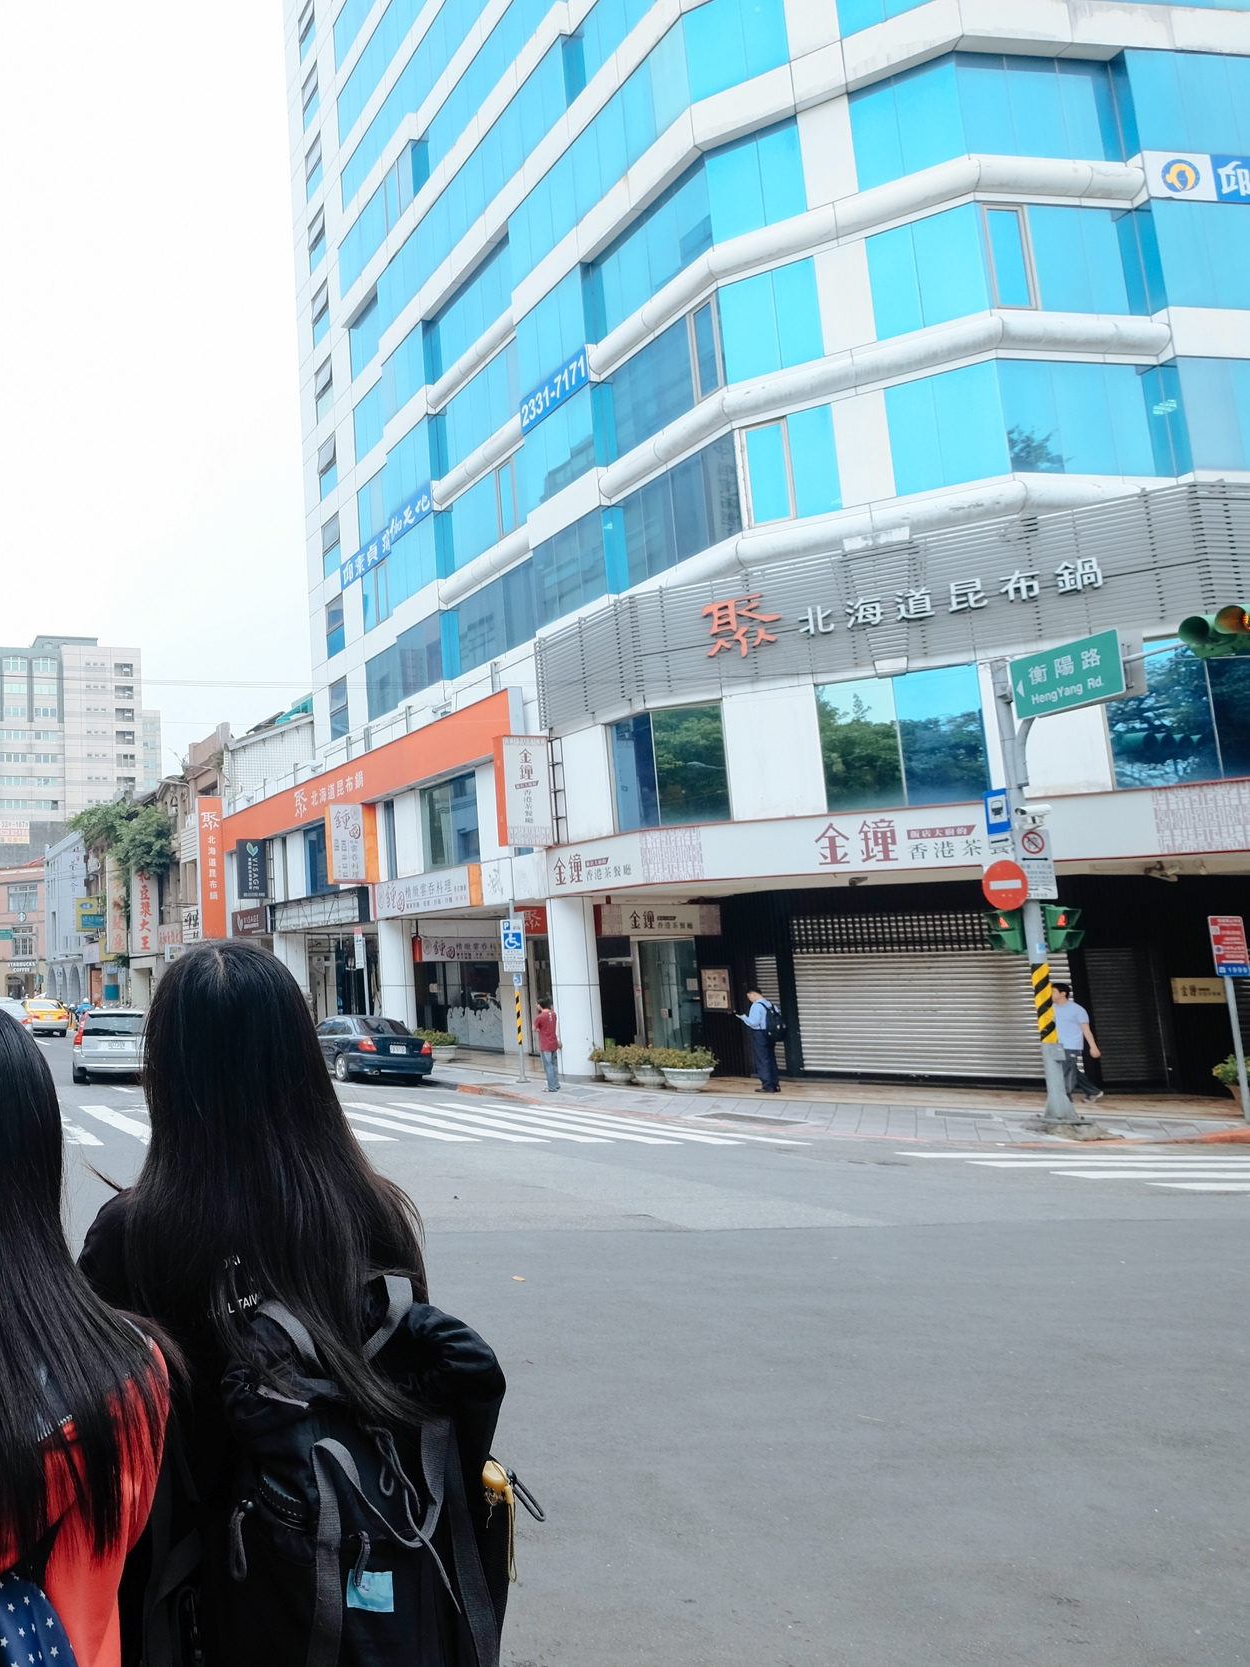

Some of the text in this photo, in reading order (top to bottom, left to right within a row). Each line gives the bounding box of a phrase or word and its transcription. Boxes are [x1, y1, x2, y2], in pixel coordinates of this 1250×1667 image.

[520, 351, 587, 428] 2331-7171
[700, 556, 1104, 659] 聚 北海道昆布鍋
[1028, 648, 1101, 685] 衡陽路
[1031, 676, 1105, 705] HengYang Rd.
[294, 770, 364, 818] 聚 北海道昆布鍋
[201, 811, 220, 830] 聚
[814, 818, 899, 866] 金鐘
[207, 835, 218, 900] 北海道昆布鍋
[252, 857, 260, 890] VISAGE
[553, 853, 583, 886] 金鐘
[586, 863, 632, 882] 香港茶餐廳
